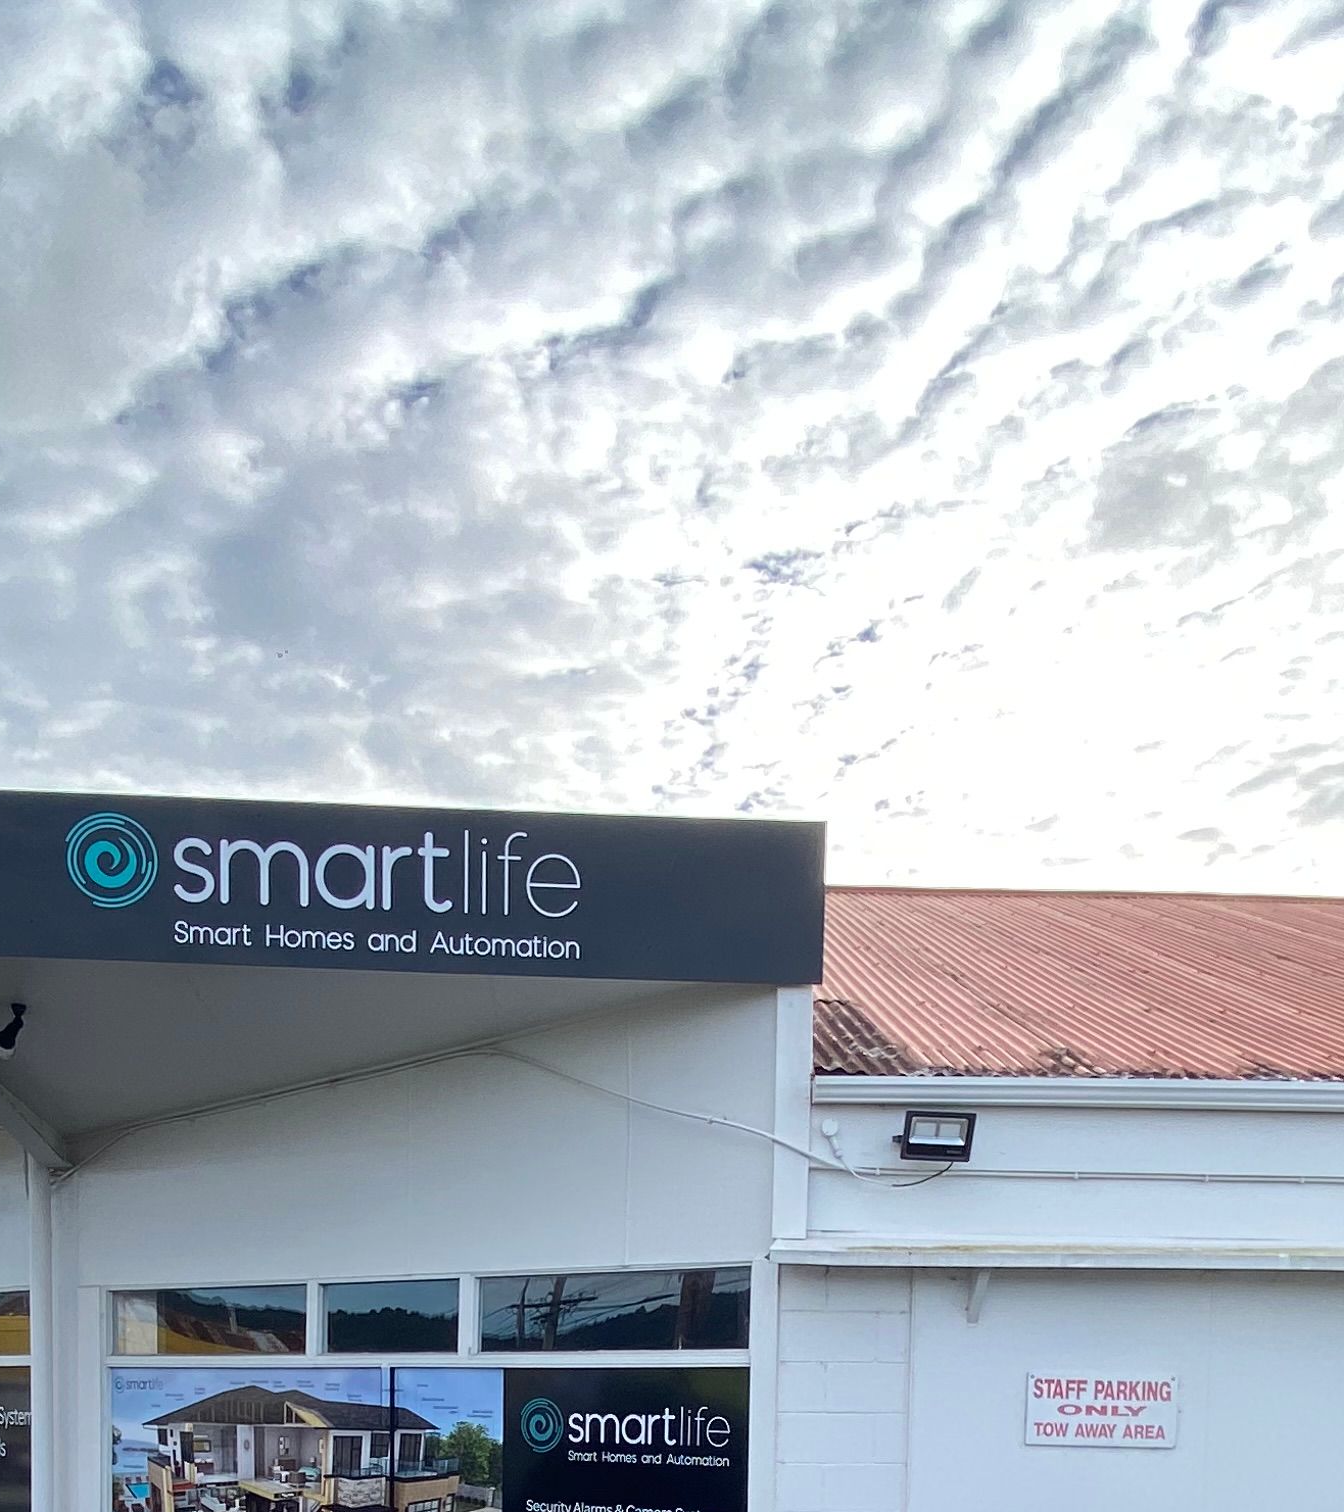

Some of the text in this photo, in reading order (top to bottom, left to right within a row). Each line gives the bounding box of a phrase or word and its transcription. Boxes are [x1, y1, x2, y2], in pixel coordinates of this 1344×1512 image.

[172, 829, 582, 919] smartlife
[173, 919, 581, 960] Smart Homes and Automation
[1033, 1378, 1172, 1402] STAFF PARKING
[1057, 1404, 1147, 1417] ONLY
[568, 1406, 731, 1448] smartlife
[1034, 1422, 1166, 1440] TOW AWAY AREA
[568, 1450, 730, 1468] Smart Homes and Automation
